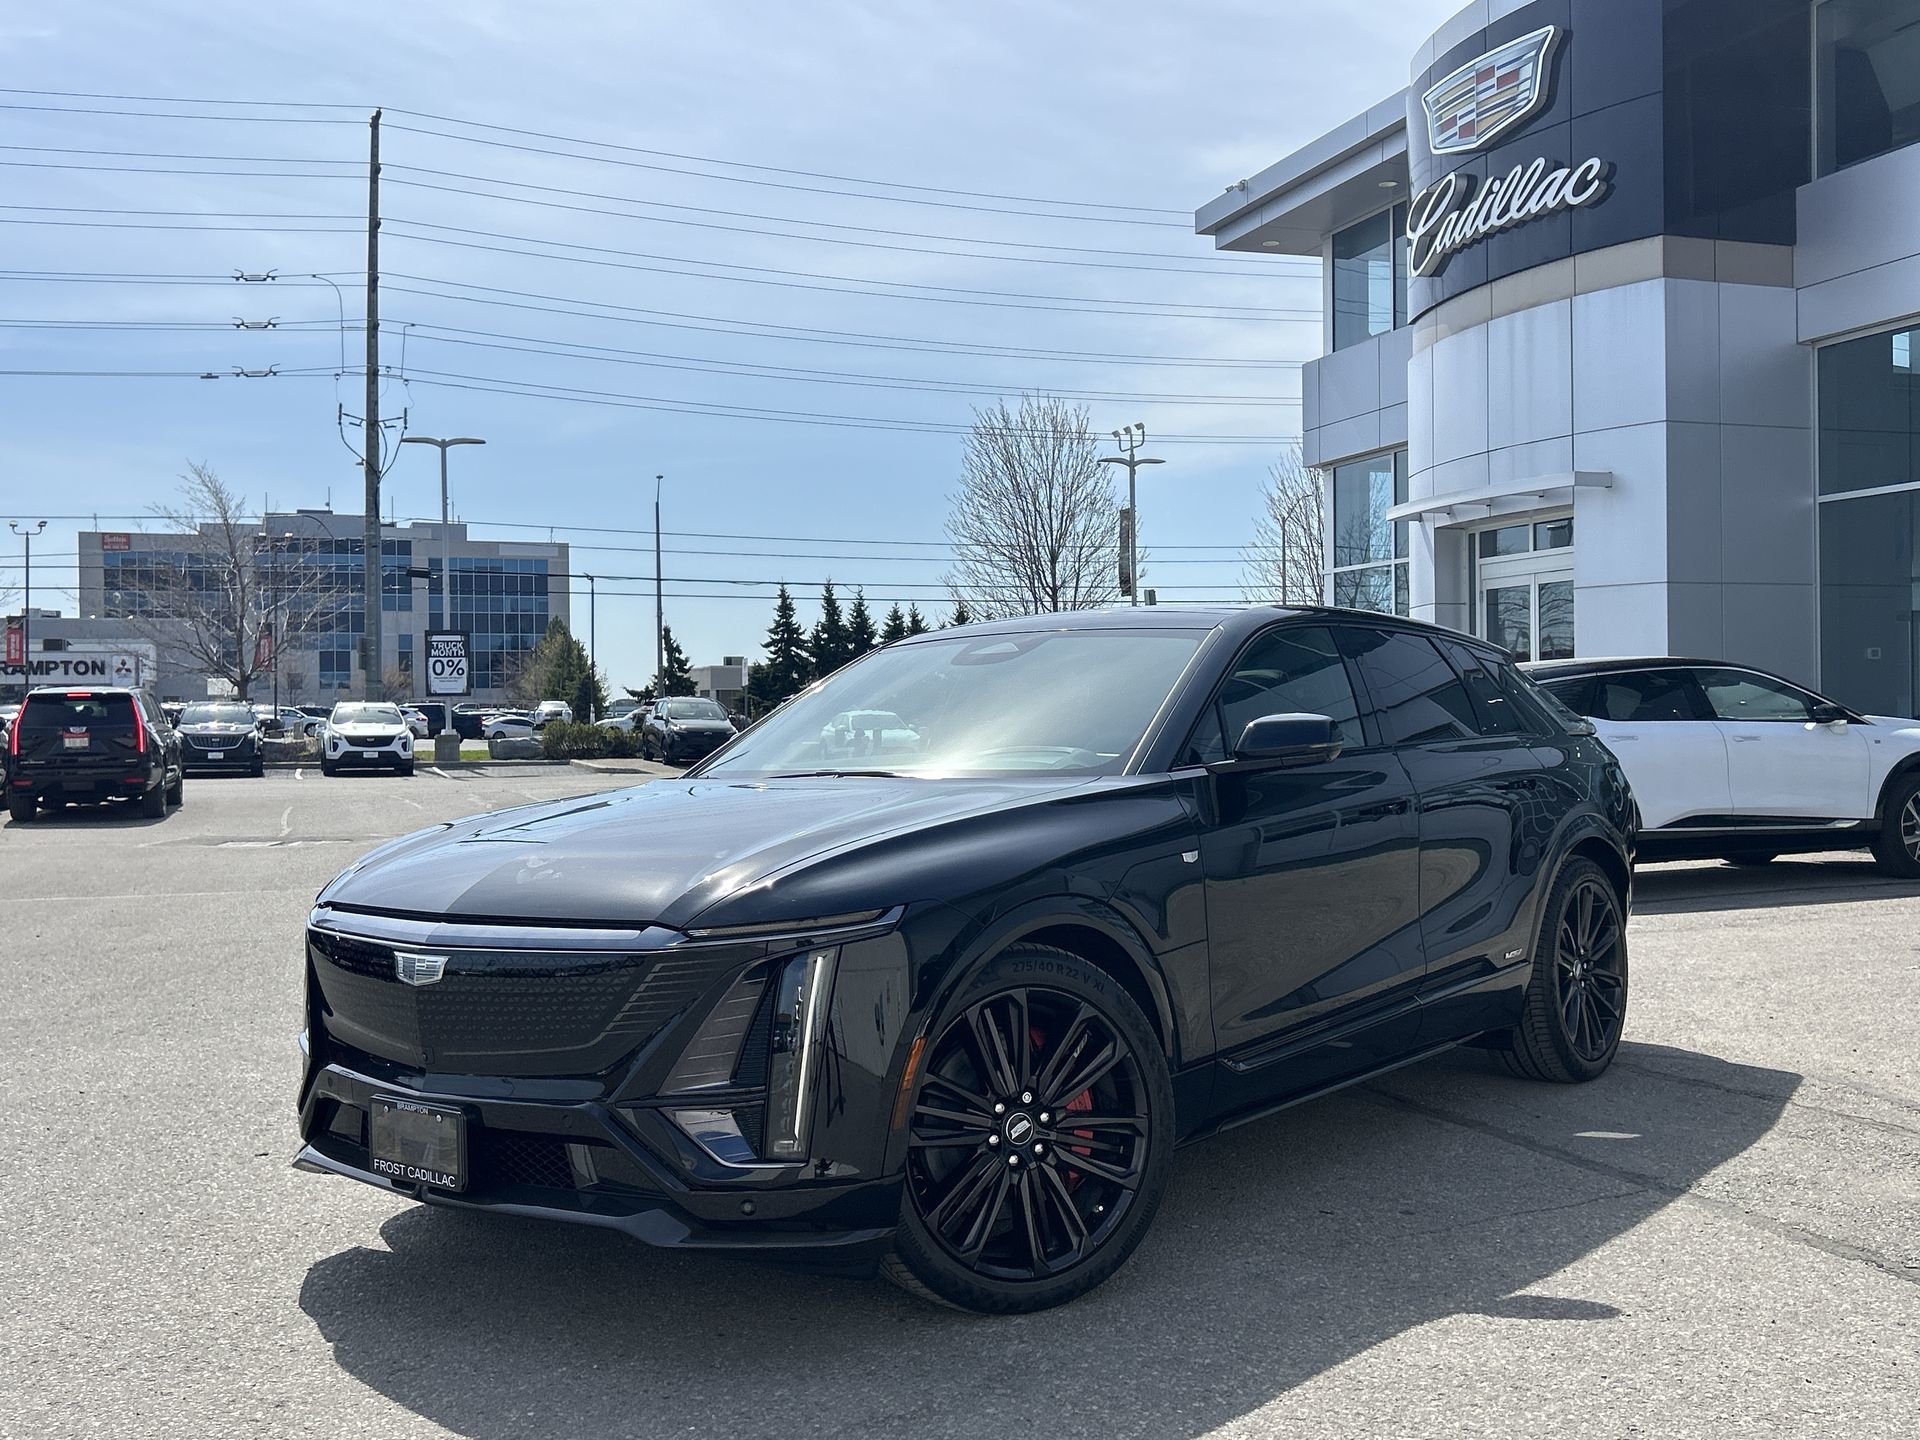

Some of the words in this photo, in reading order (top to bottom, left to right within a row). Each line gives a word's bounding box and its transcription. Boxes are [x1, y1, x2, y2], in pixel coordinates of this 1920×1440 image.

[1406, 156, 1602, 278] Cadillac
[433, 659, 465, 676] 0%
[1011, 959, 1054, 973] 275/40
[396, 1102, 429, 1115] BRAMPTON
[373, 1158, 406, 1176] FROST
[407, 1166, 456, 1188] CADILLAC
